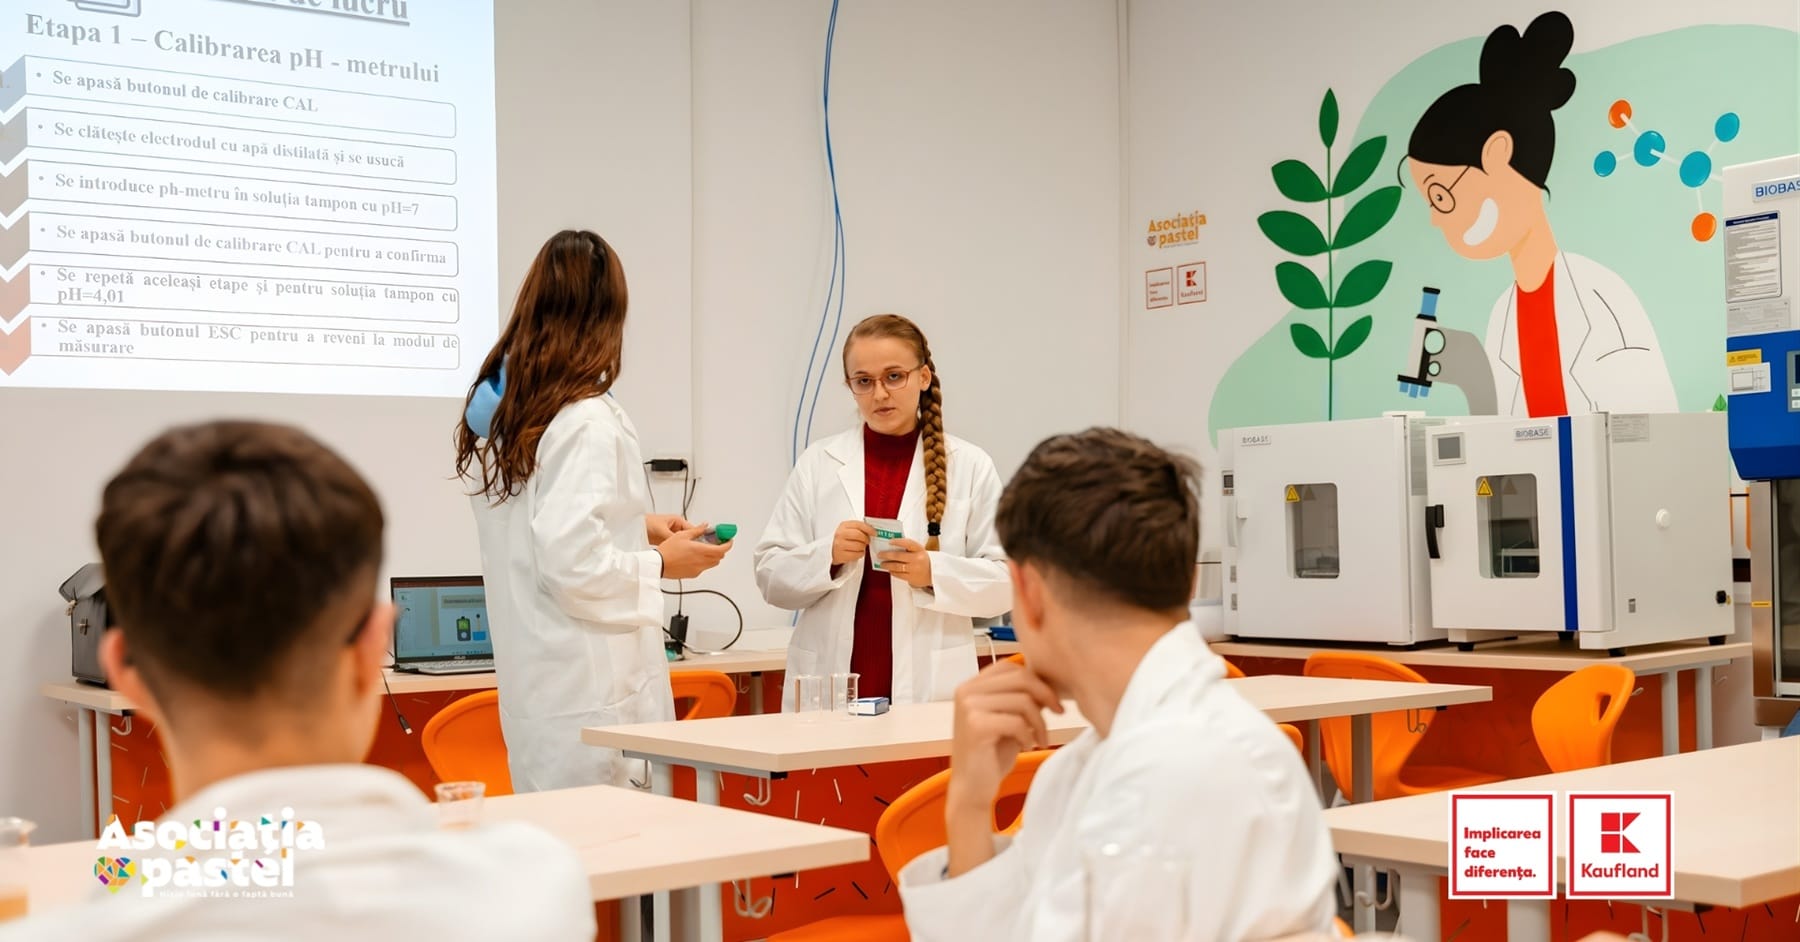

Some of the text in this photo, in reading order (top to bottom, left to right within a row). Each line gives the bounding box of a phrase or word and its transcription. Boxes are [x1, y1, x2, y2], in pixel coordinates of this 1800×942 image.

[25, 13, 101, 45] Etapa
[111, 25, 121, 44] 1
[154, 30, 281, 64] Calibrarea
[290, 48, 323, 71] pH
[347, 58, 439, 83] metrului
[53, 70, 318, 112] Se apasă butonul de calibrare CAL
[54, 121, 73, 136] Se
[78, 125, 138, 144] clătește
[141, 131, 216, 150] electrodul
[221, 141, 237, 152] cu
[242, 142, 268, 157] apă
[273, 144, 329, 162] distilată
[349, 154, 362, 164] se
[367, 156, 405, 168] usucă
[56, 173, 420, 217] Se introduce ph-metru în soluția tampon cu pH=7
[57, 225, 446, 264] Se apasă butonul de calibrare CAL pentru a confirma
[1159, 225, 1199, 248] pastel
[57, 267, 457, 303] Se repetă aceleași etape și pentru soluția tampon cu
[57, 287, 124, 305] pH=4,01
[58, 319, 458, 349] Se apasă butonul ESC pentru a reveni la modul de
[59, 339, 134, 354] măsurare
